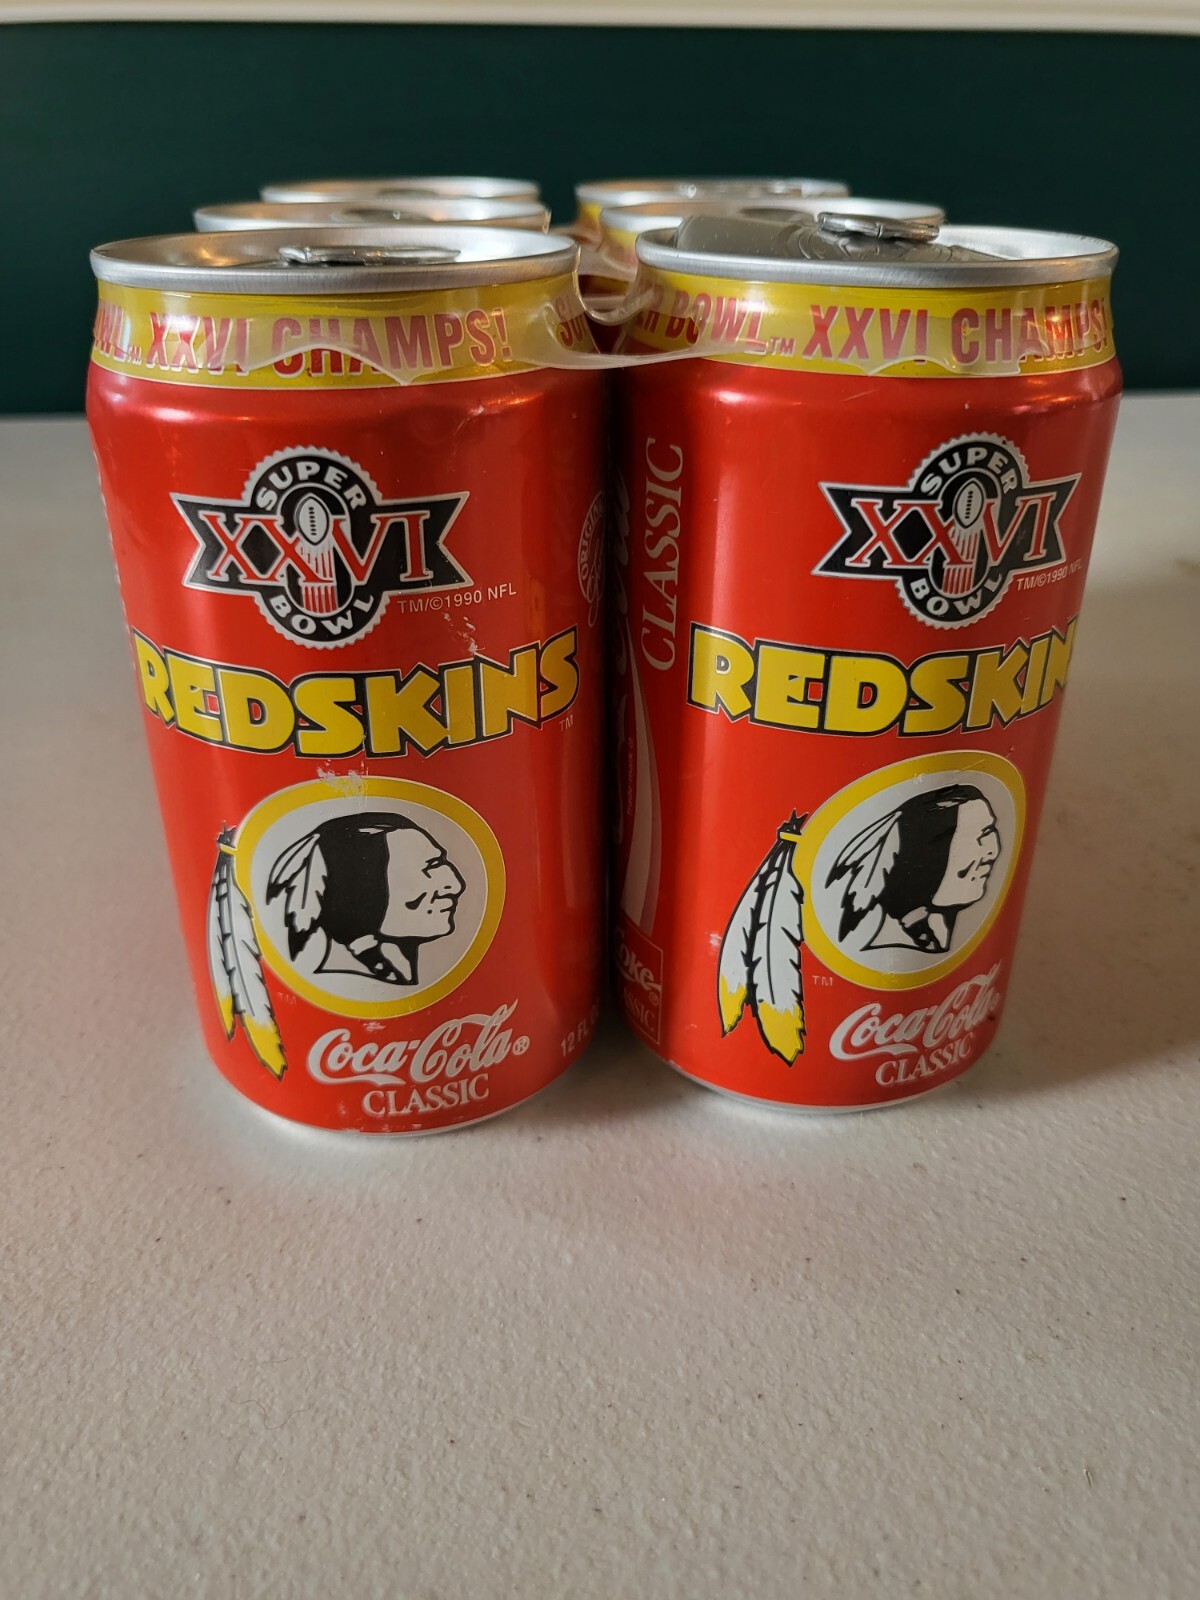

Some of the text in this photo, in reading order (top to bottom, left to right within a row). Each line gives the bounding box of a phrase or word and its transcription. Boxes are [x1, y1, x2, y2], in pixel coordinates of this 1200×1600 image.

[146, 311, 250, 376] XXVI
[271, 307, 515, 378] CHAMPS!
[664, 286, 768, 356] BOWL
[802, 303, 929, 365] XXVI
[255, 461, 368, 512] SUPER
[920, 446, 1017, 495] SUPER
[198, 509, 434, 583] XXVI
[641, 437, 684, 672] CLASSIC
[846, 491, 1056, 569] XXVI
[272, 593, 377, 636] BOWL
[488, 582, 517, 600] NFL
[910, 572, 1003, 618] BOWL
[131, 624, 580, 759] REDSKINS
[811, 974, 834, 987] TM
[875, 1031, 975, 1088] CLASSIC
[362, 1072, 490, 1118] CLASSIC
